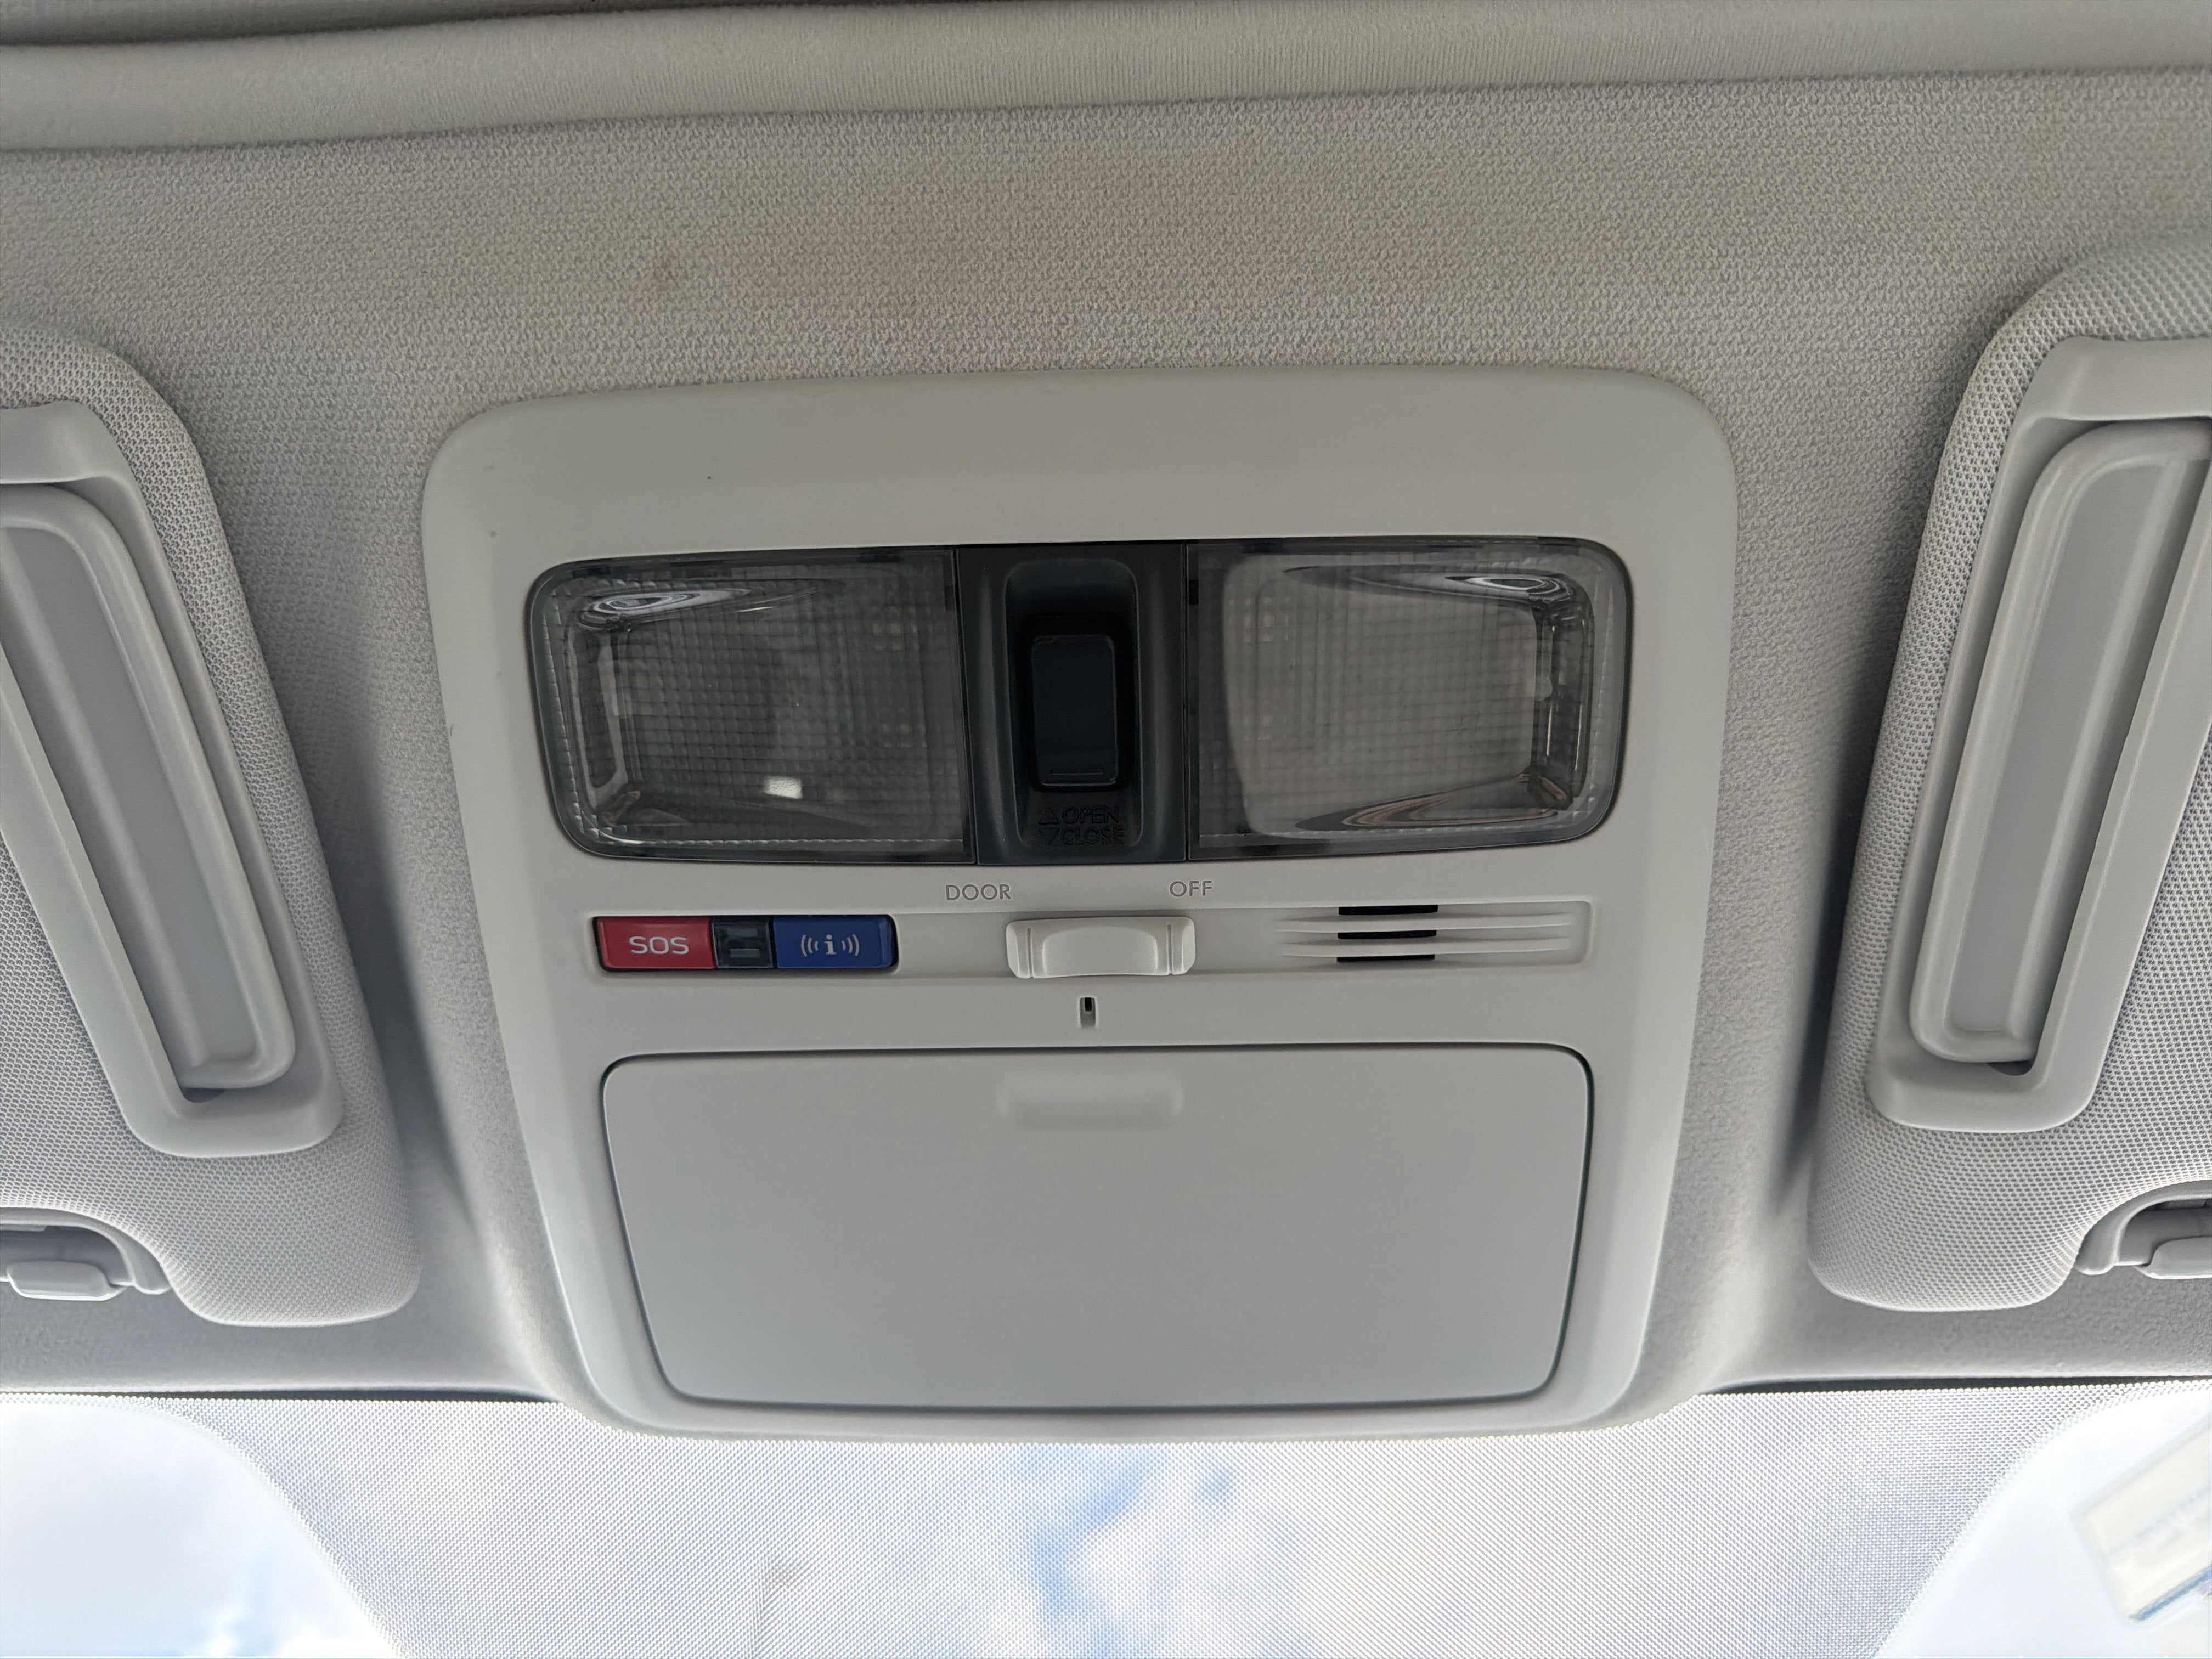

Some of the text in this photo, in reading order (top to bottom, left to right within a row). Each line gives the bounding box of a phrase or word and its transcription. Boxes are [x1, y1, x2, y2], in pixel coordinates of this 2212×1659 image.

[1062, 804, 1120, 824] OPEN
[1061, 826, 1125, 845] CLOSE
[945, 884, 1012, 901] DOOR
[1169, 880, 1213, 897] OFF
[629, 935, 690, 956] SOS
